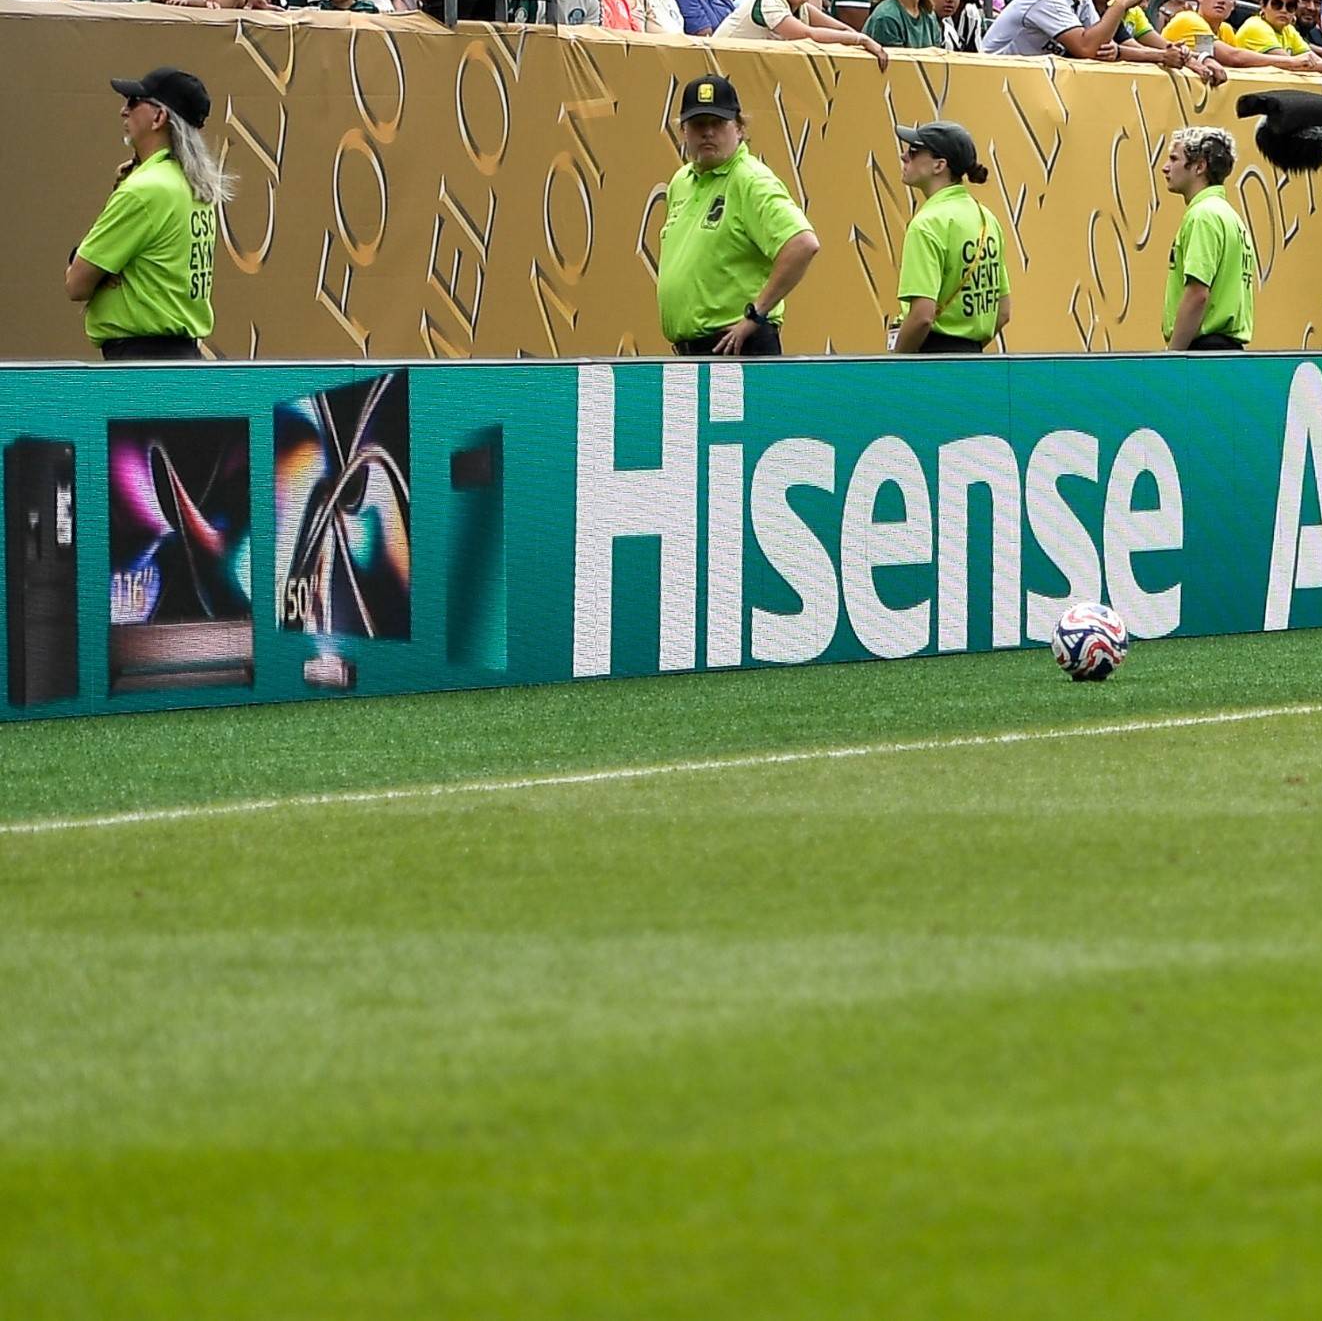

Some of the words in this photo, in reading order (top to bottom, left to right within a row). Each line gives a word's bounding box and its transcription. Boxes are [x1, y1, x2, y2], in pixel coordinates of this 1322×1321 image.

[190, 210, 214, 238] CSC
[962, 236, 998, 264] CSC
[961, 262, 999, 291] EVENT
[962, 288, 1001, 317] STAFF
[573, 362, 1184, 677] Hisense
